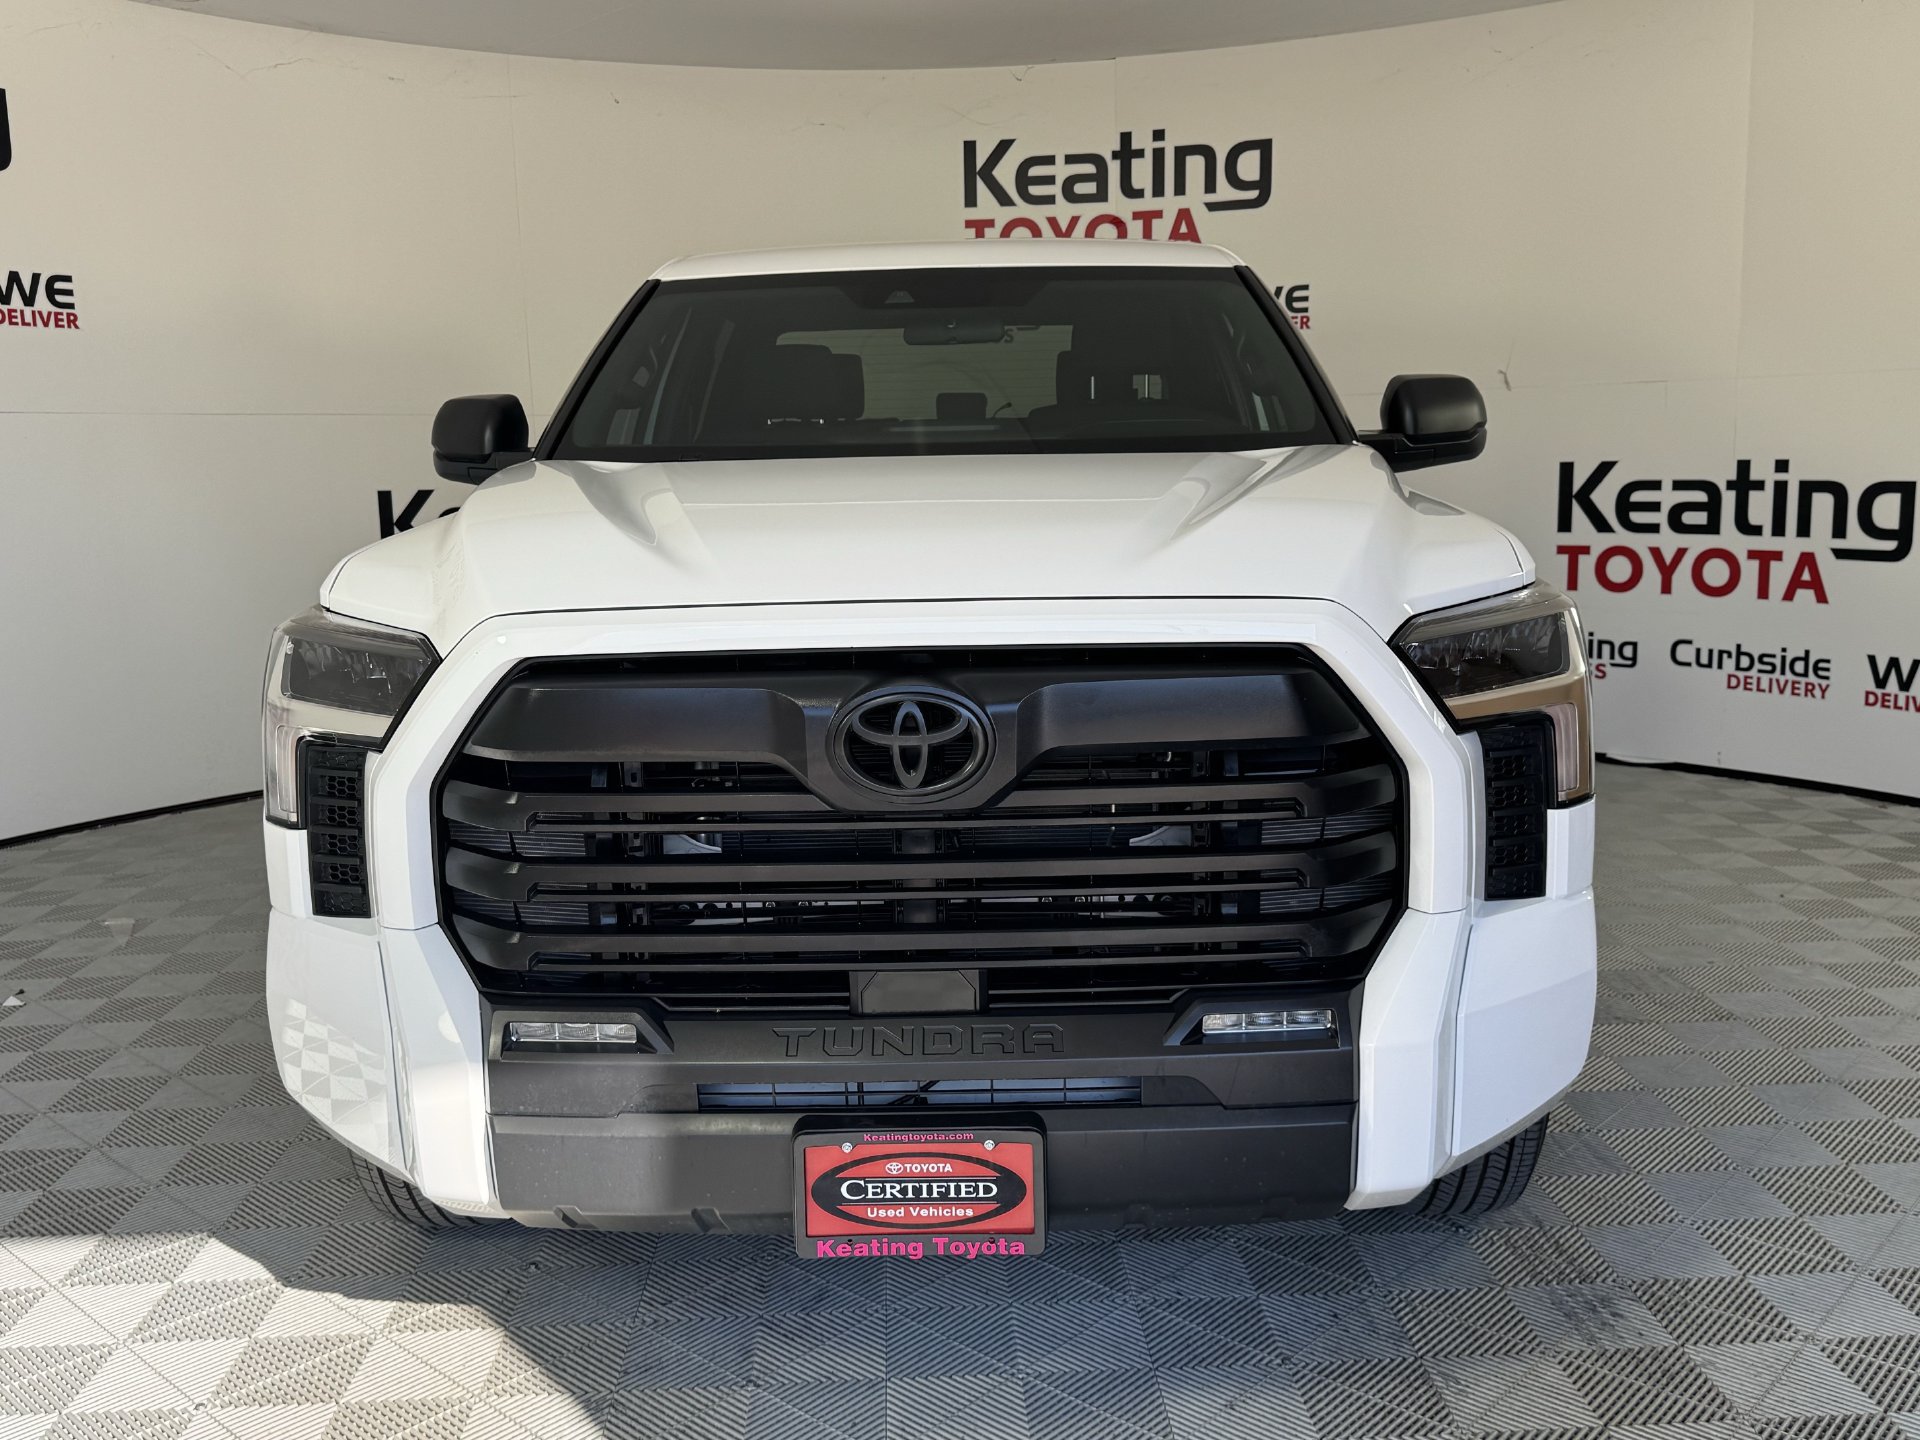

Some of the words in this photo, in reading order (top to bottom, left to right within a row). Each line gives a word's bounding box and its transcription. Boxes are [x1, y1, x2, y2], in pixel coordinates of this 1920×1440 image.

[964, 129, 1273, 213] Keating
[1557, 459, 1917, 562] Keating
[1556, 545, 1829, 604] TOYOTA
[1670, 639, 1832, 681] Curbside
[1727, 674, 1830, 699] DELIVERY
[772, 1023, 1066, 1058] TUNDRA
[863, 1132, 974, 1143] Keatingtoyota.com
[904, 1163, 953, 1173] TOYOTA
[867, 1206, 904, 1218] Used
[909, 1206, 974, 1217] Vehicles
[816, 1238, 924, 1260] Keating
[932, 1237, 1025, 1260] Toyota
